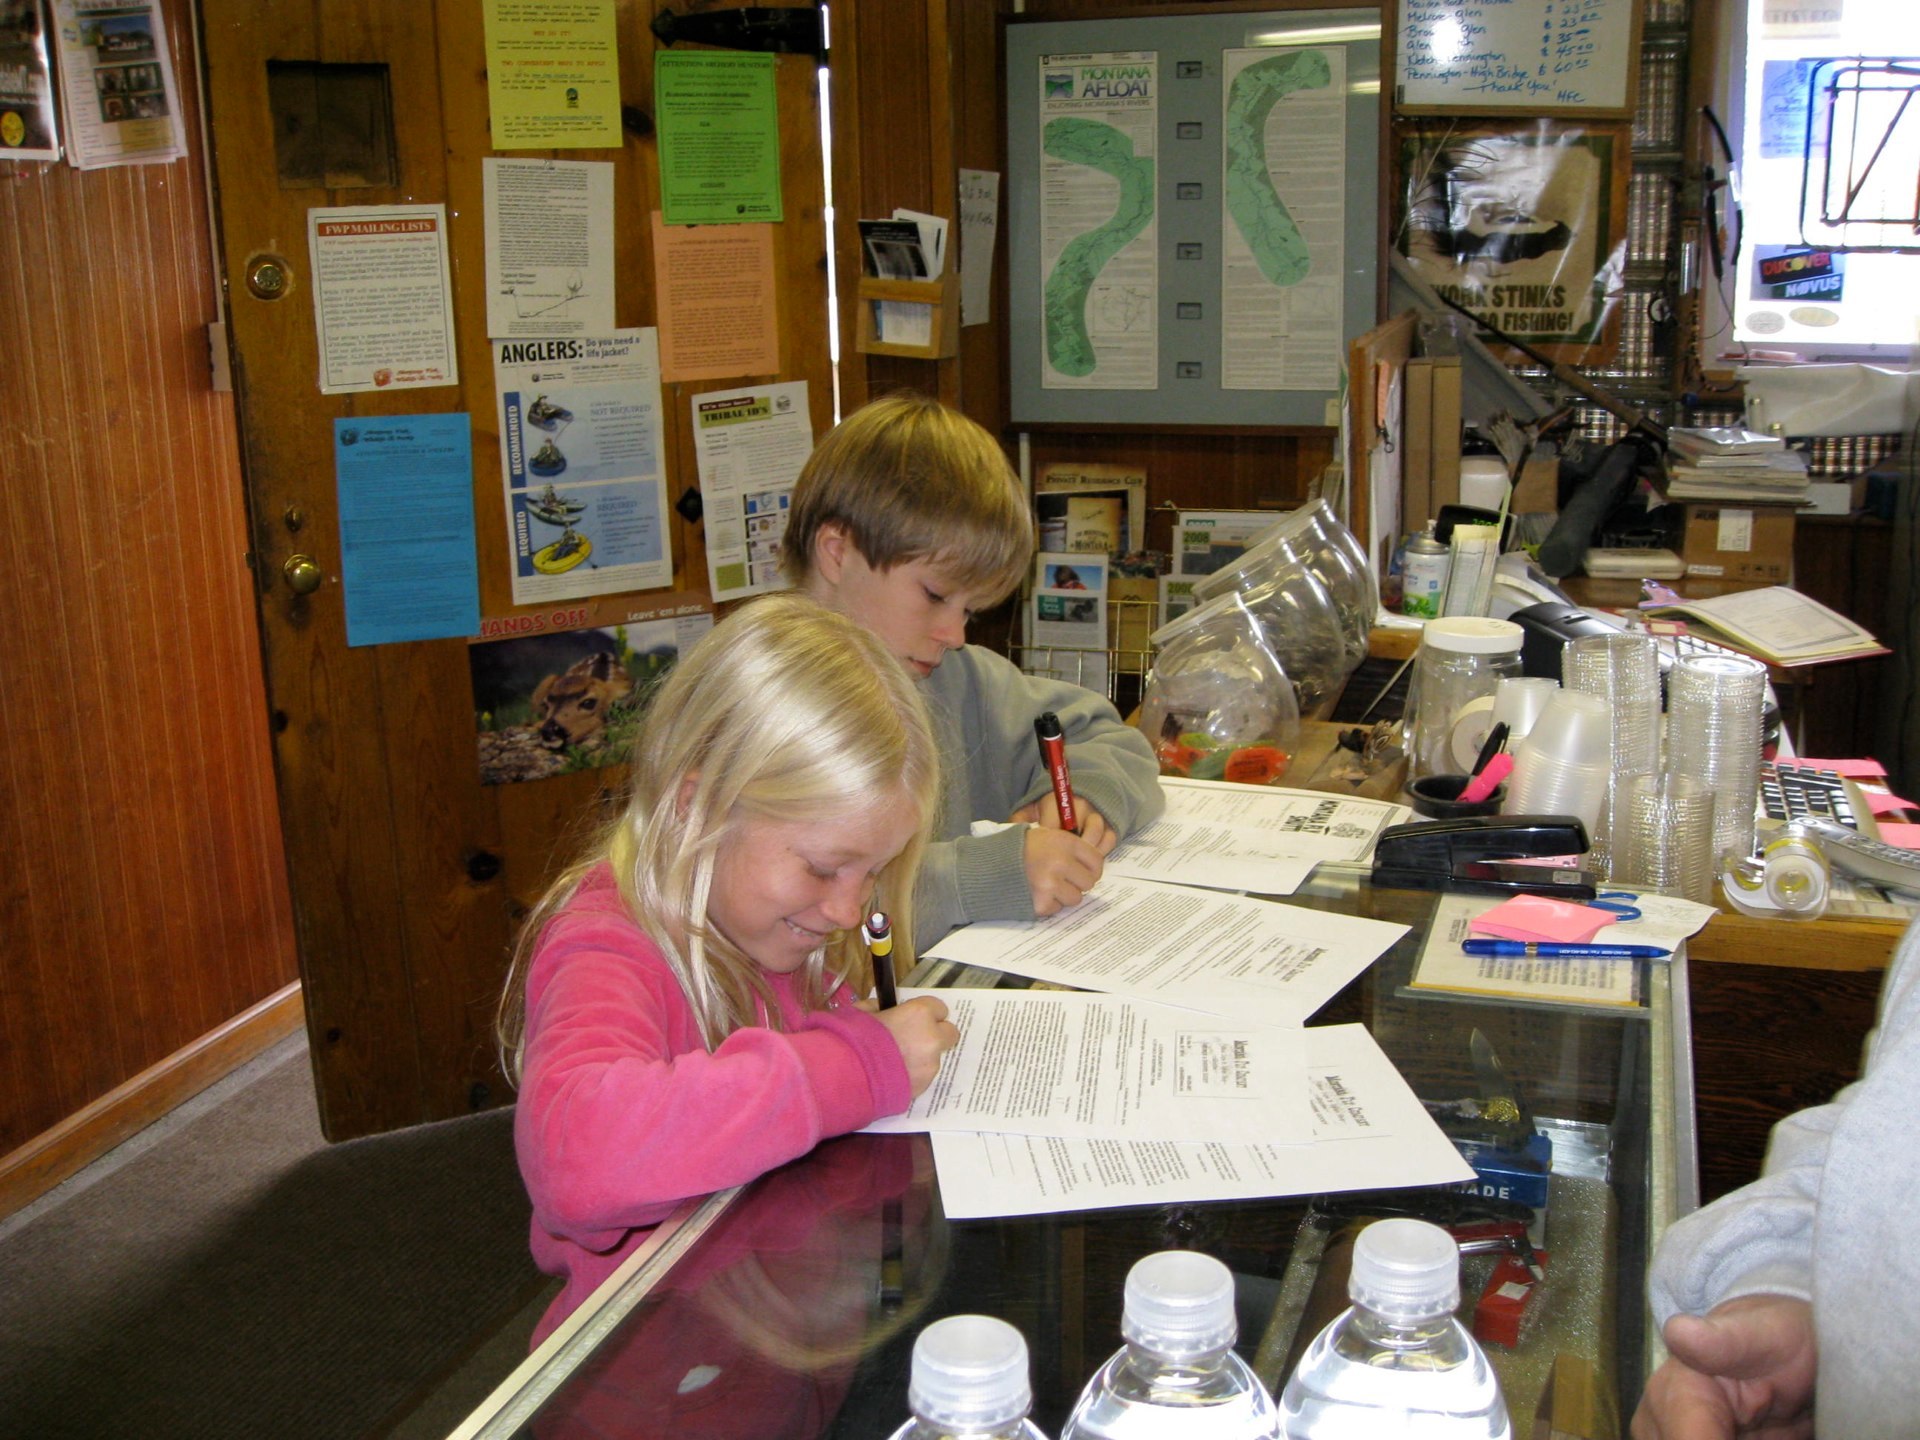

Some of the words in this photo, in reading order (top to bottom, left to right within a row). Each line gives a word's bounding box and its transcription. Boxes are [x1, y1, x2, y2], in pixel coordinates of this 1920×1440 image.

[1081, 66, 1150, 81] MONTANA
[1083, 80, 1150, 98] AFLOAT
[326, 225, 350, 235] FWP
[352, 223, 400, 233] MAILING
[401, 221, 432, 232] LISTS
[1492, 285, 1566, 308] STINKS
[1785, 276, 1841, 298] NOVUS
[1503, 311, 1574, 332] FISHING!
[501, 340, 584, 364] ANGLERS:
[586, 339, 597, 347] Do
[598, 339, 612, 348] you
[614, 336, 634, 345] need
[586, 349, 600, 358] life
[600, 346, 630, 359] jacket?
[703, 409, 743, 422] TRIBAL
[507, 405, 522, 476] RECOMMENDED
[516, 511, 529, 557] REQUIRED
[551, 608, 588, 627] OFF
[627, 609, 655, 621] Leave
[1459, 1184, 1511, 1200] ADE
